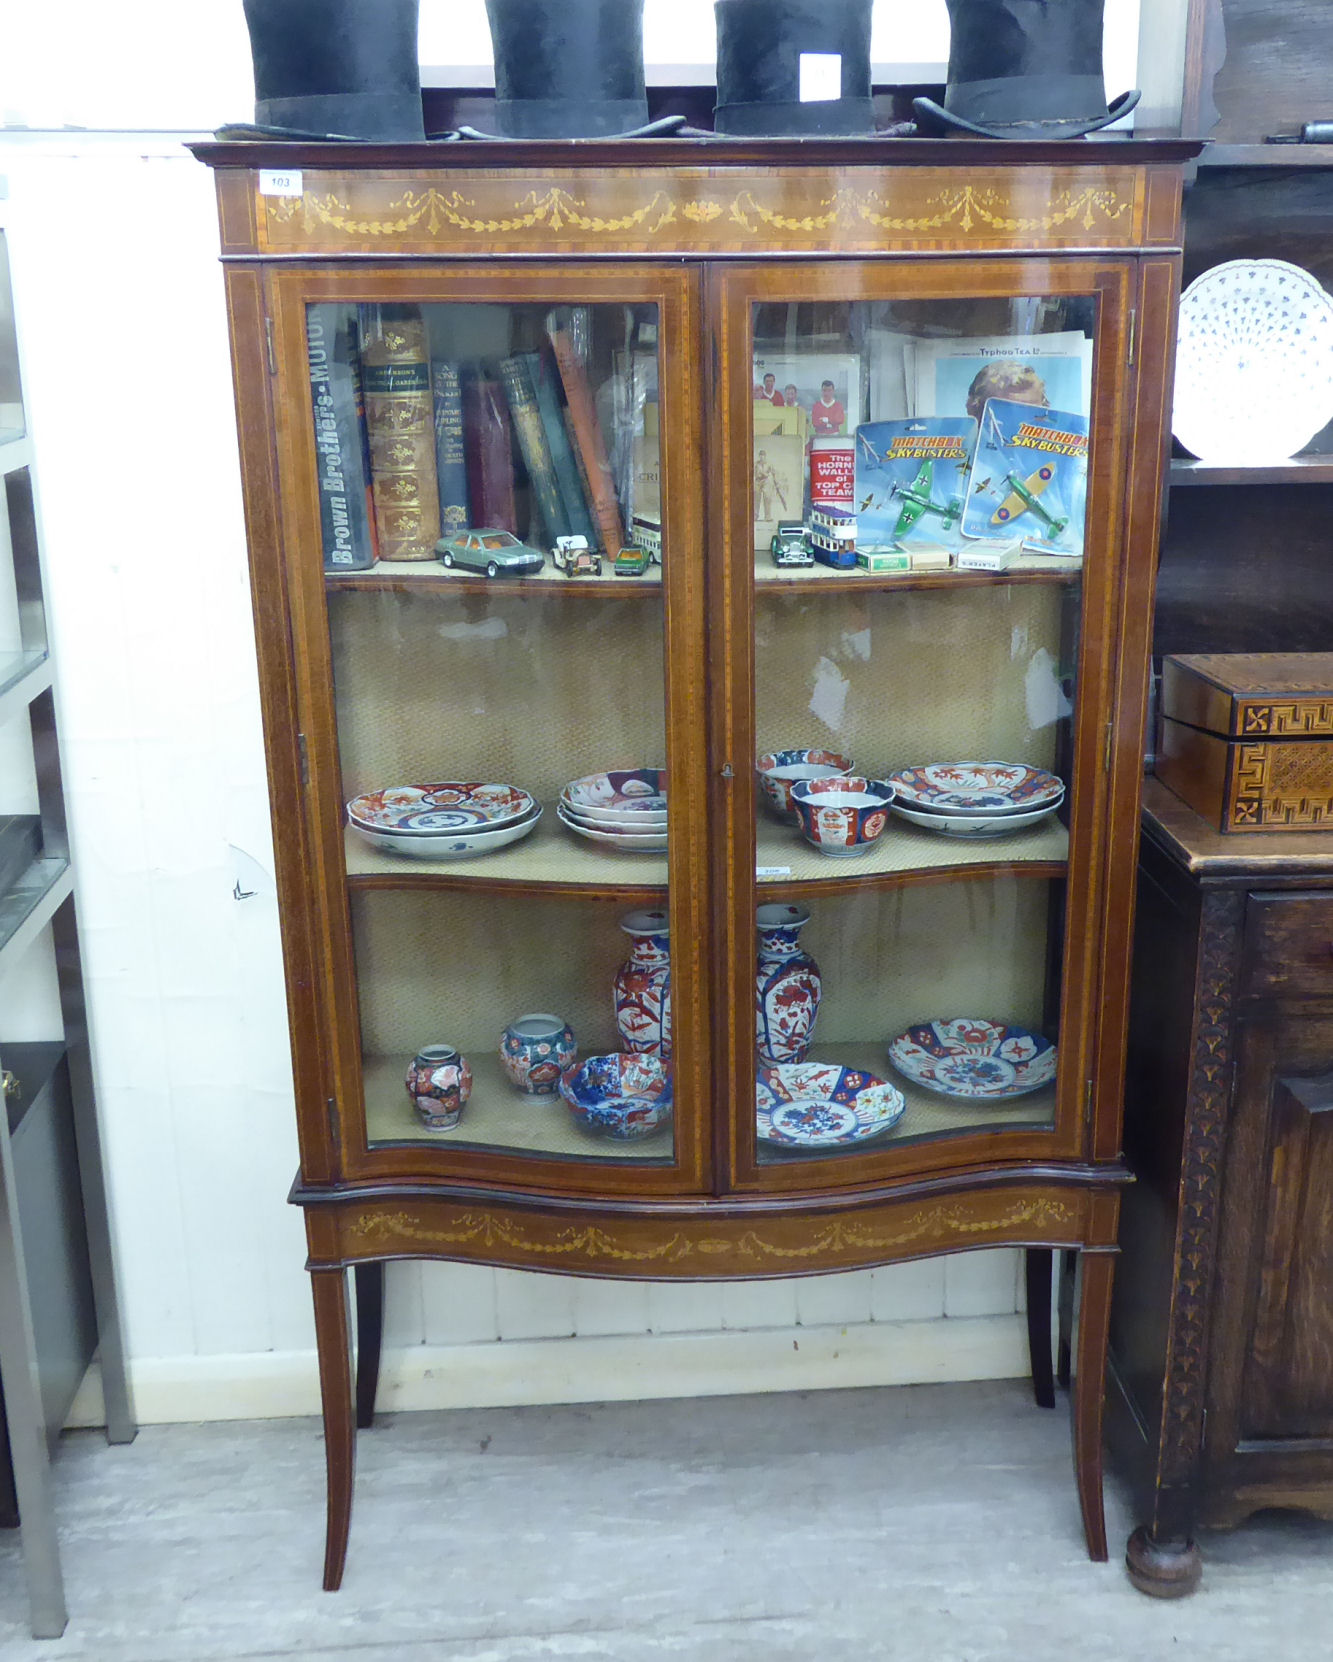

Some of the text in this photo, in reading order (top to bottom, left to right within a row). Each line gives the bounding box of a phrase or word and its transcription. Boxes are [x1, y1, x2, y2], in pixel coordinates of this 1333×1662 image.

[271, 178, 290, 188] 103
[317, 395, 345, 491] Brothers
[891, 436, 965, 448] MATCHBOX
[1017, 422, 1088, 448] MATCHBOX
[330, 497, 353, 564] Brown
